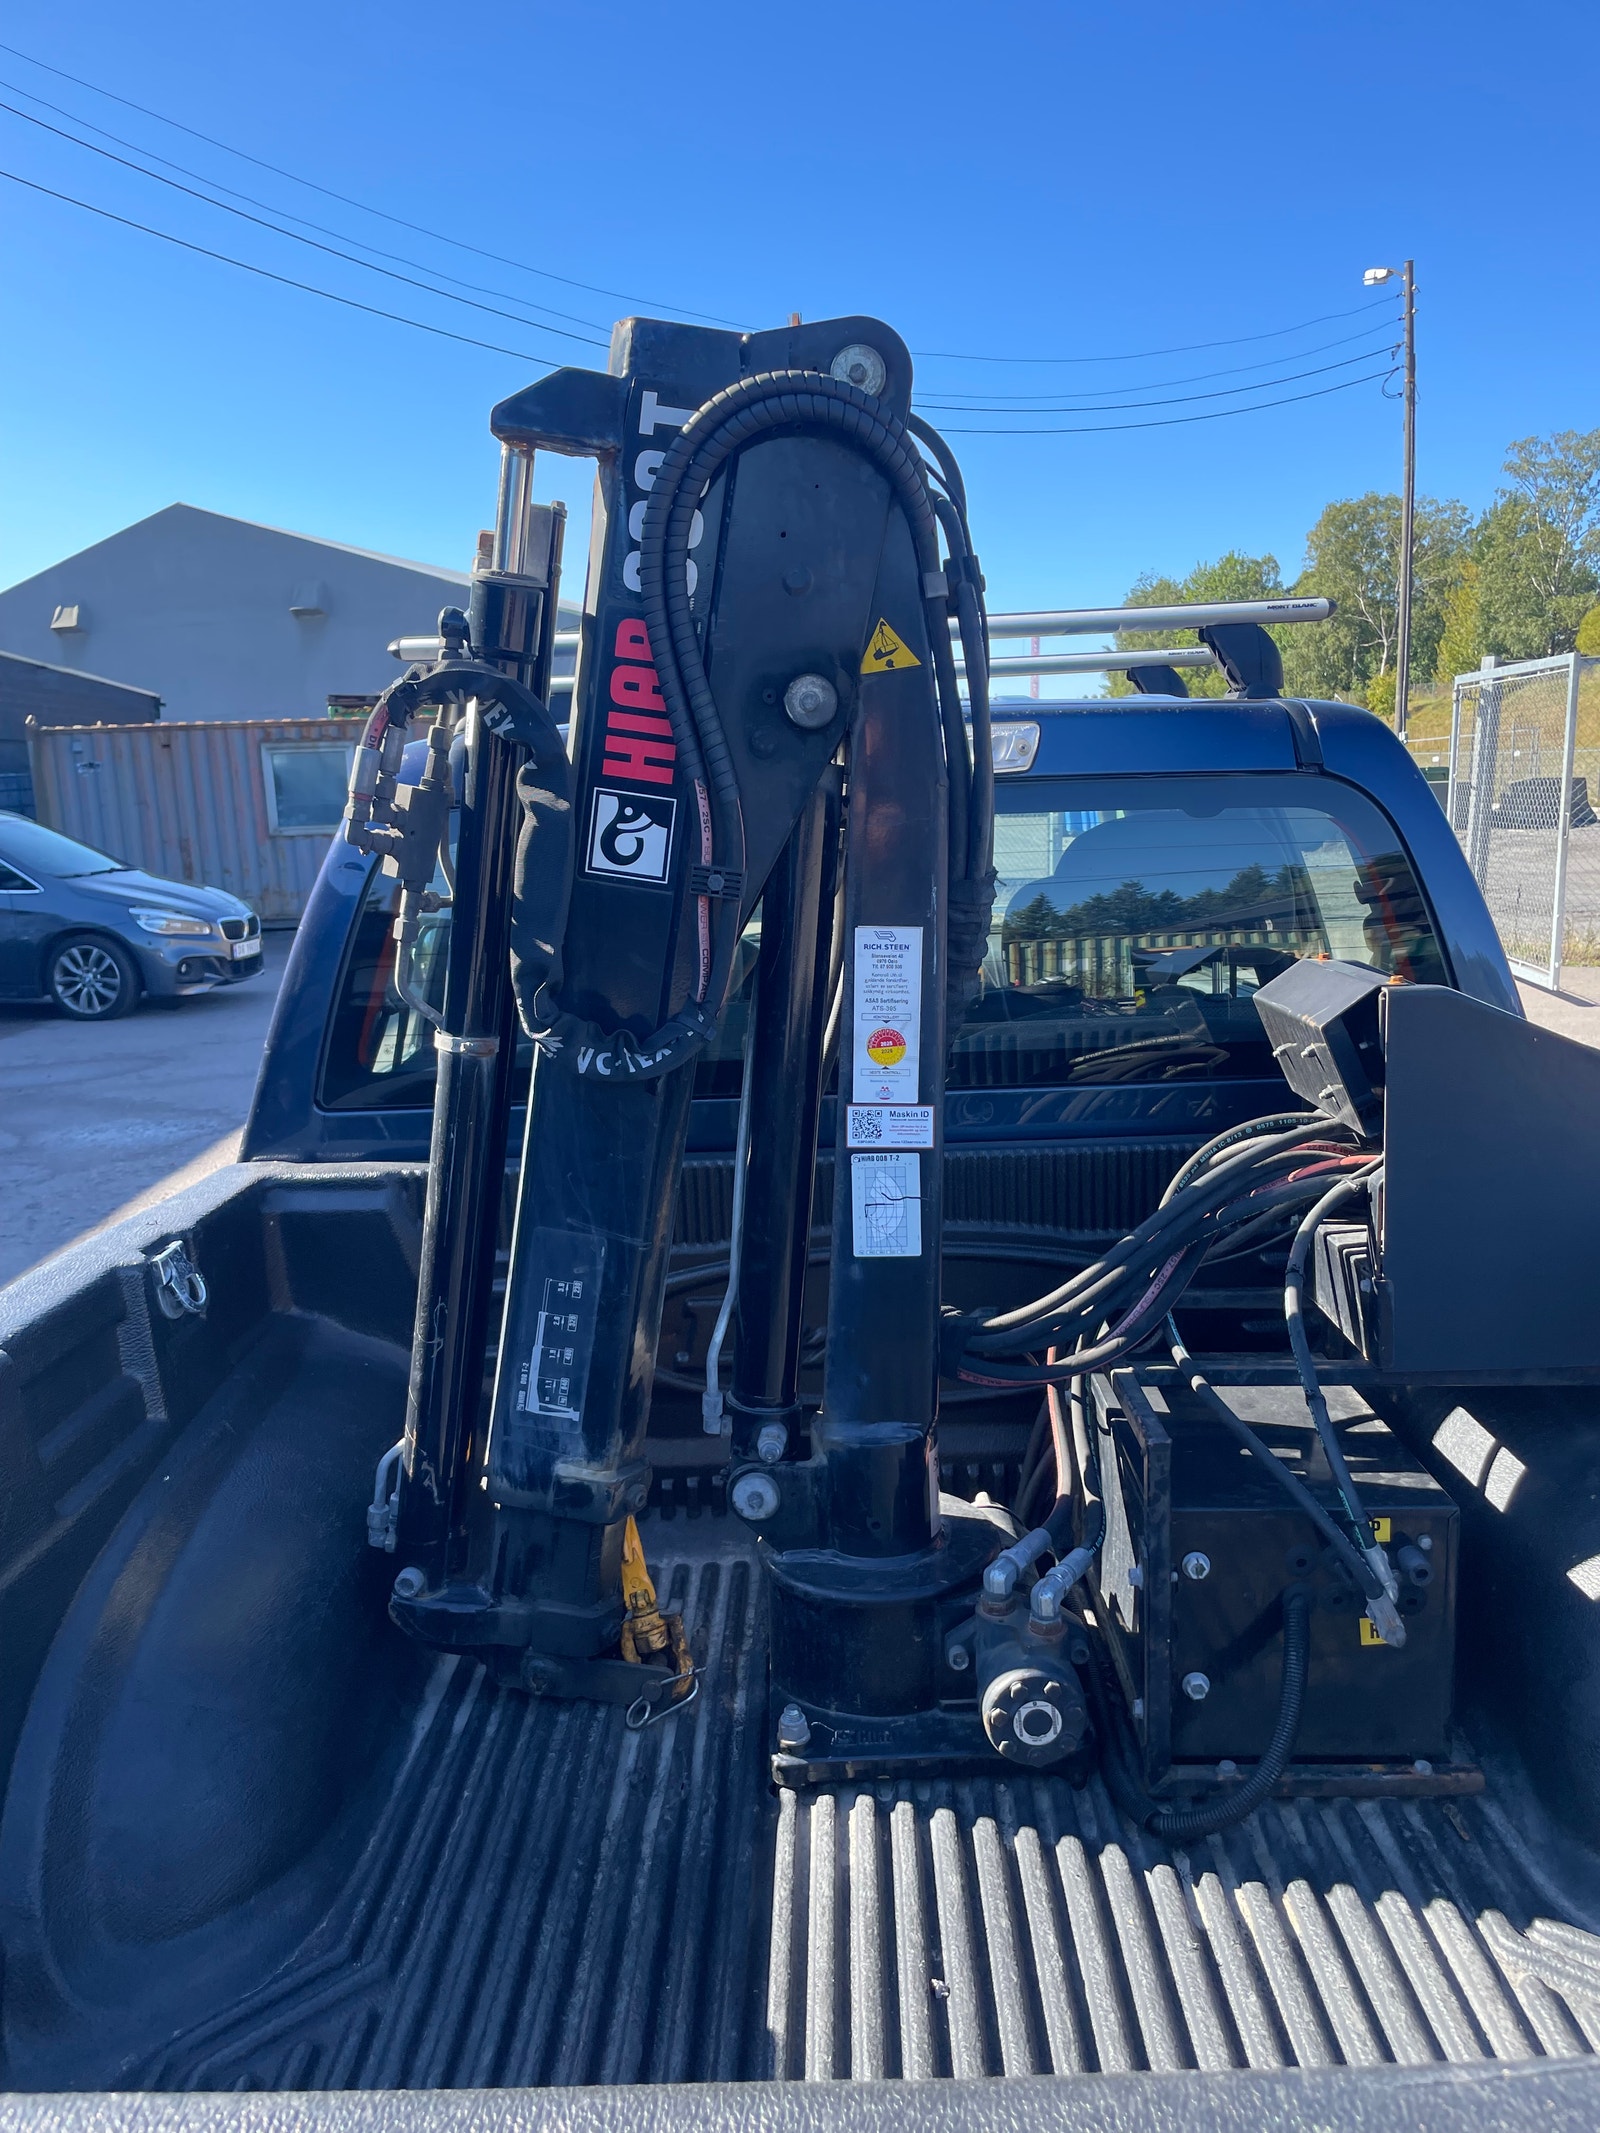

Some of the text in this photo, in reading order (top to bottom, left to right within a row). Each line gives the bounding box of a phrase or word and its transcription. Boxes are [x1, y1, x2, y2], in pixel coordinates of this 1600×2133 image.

[702, 811, 711, 833] 2SC
[889, 1110, 930, 1118] Maskin ID
